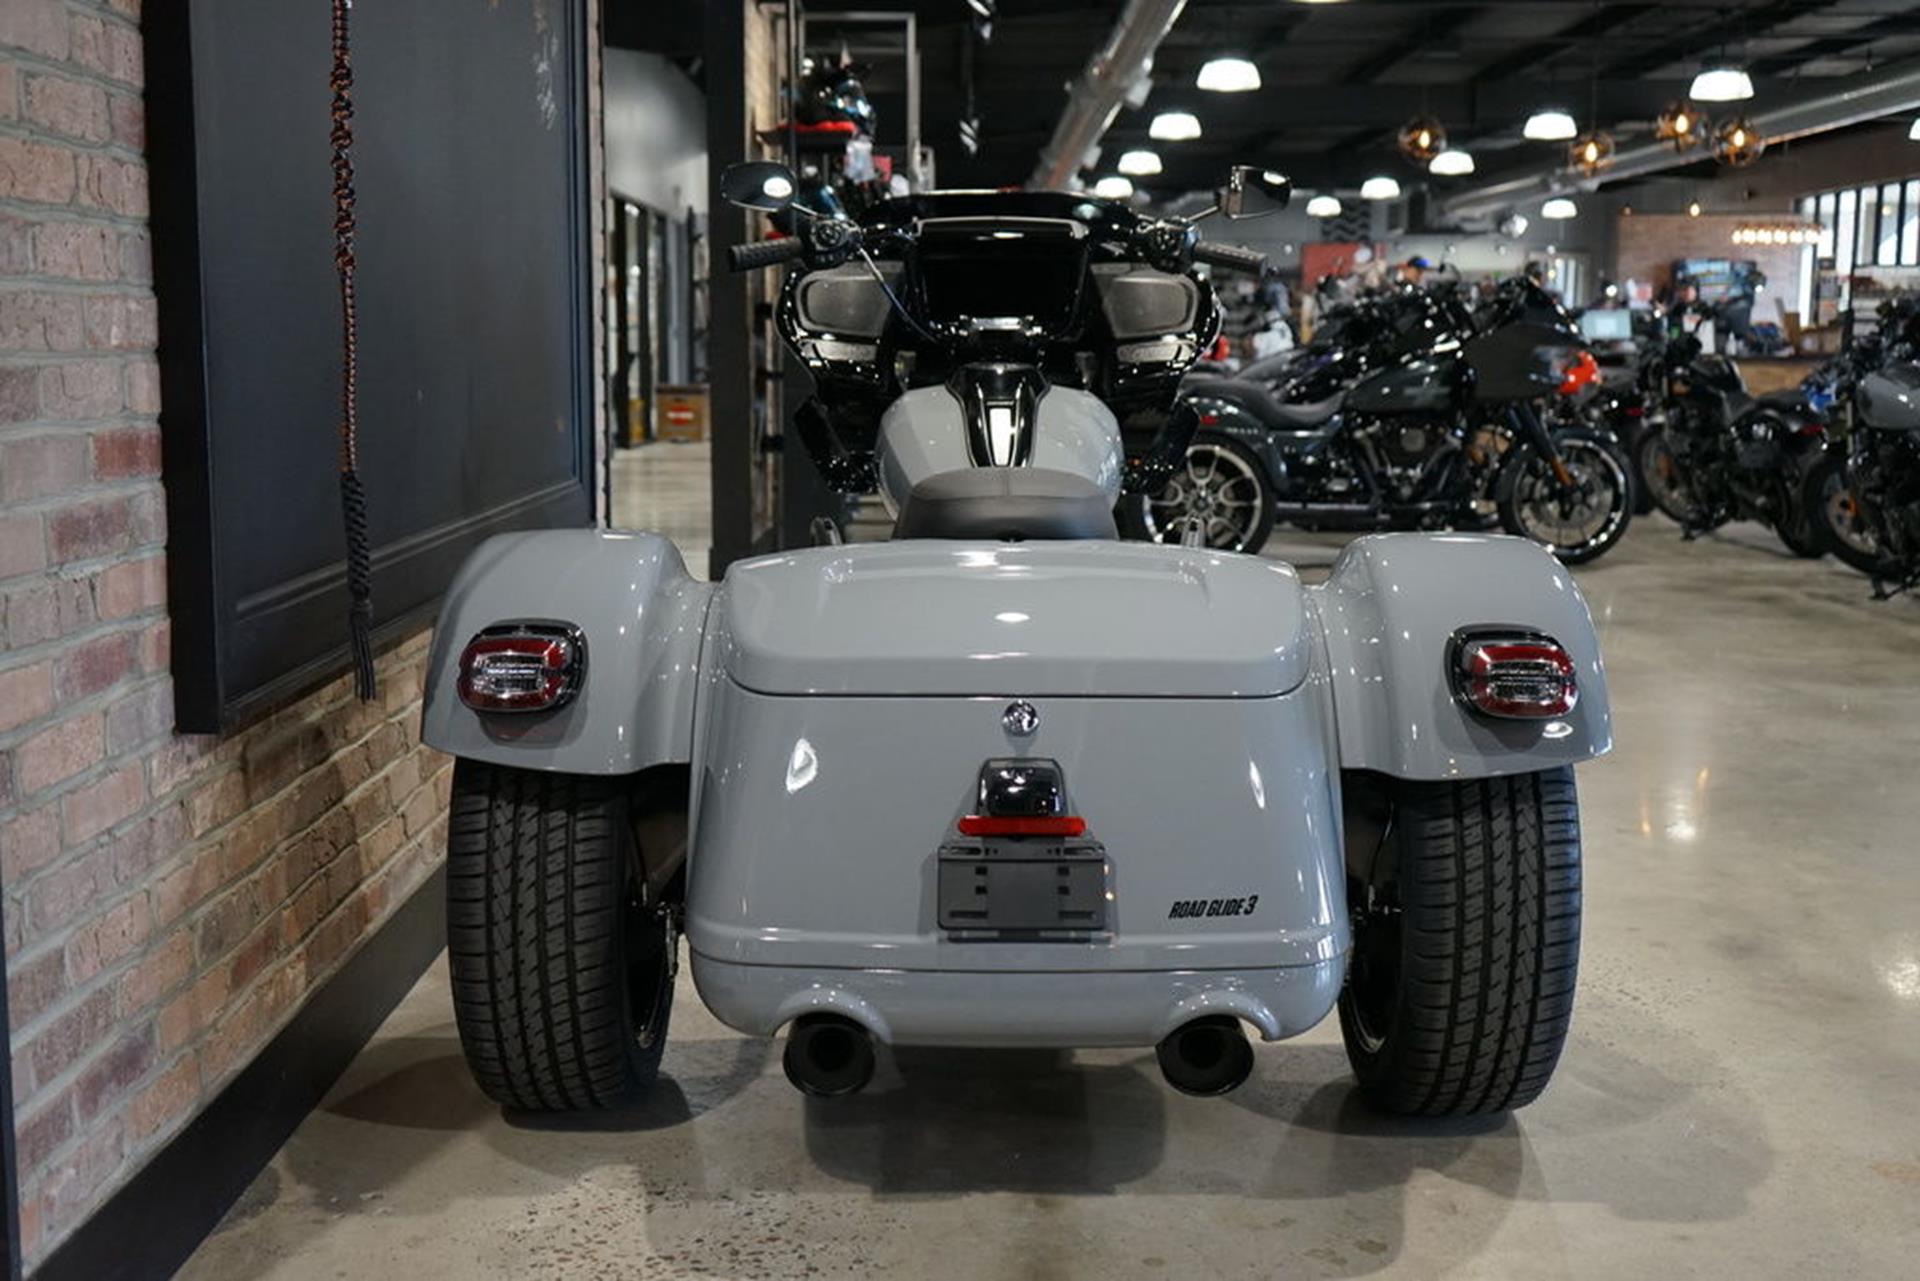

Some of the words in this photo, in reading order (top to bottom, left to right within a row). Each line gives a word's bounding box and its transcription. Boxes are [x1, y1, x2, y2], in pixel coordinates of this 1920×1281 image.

[1168, 900, 1208, 919] ROAD
[1206, 898, 1245, 917] GLIDE
[1243, 894, 1259, 916] 3
